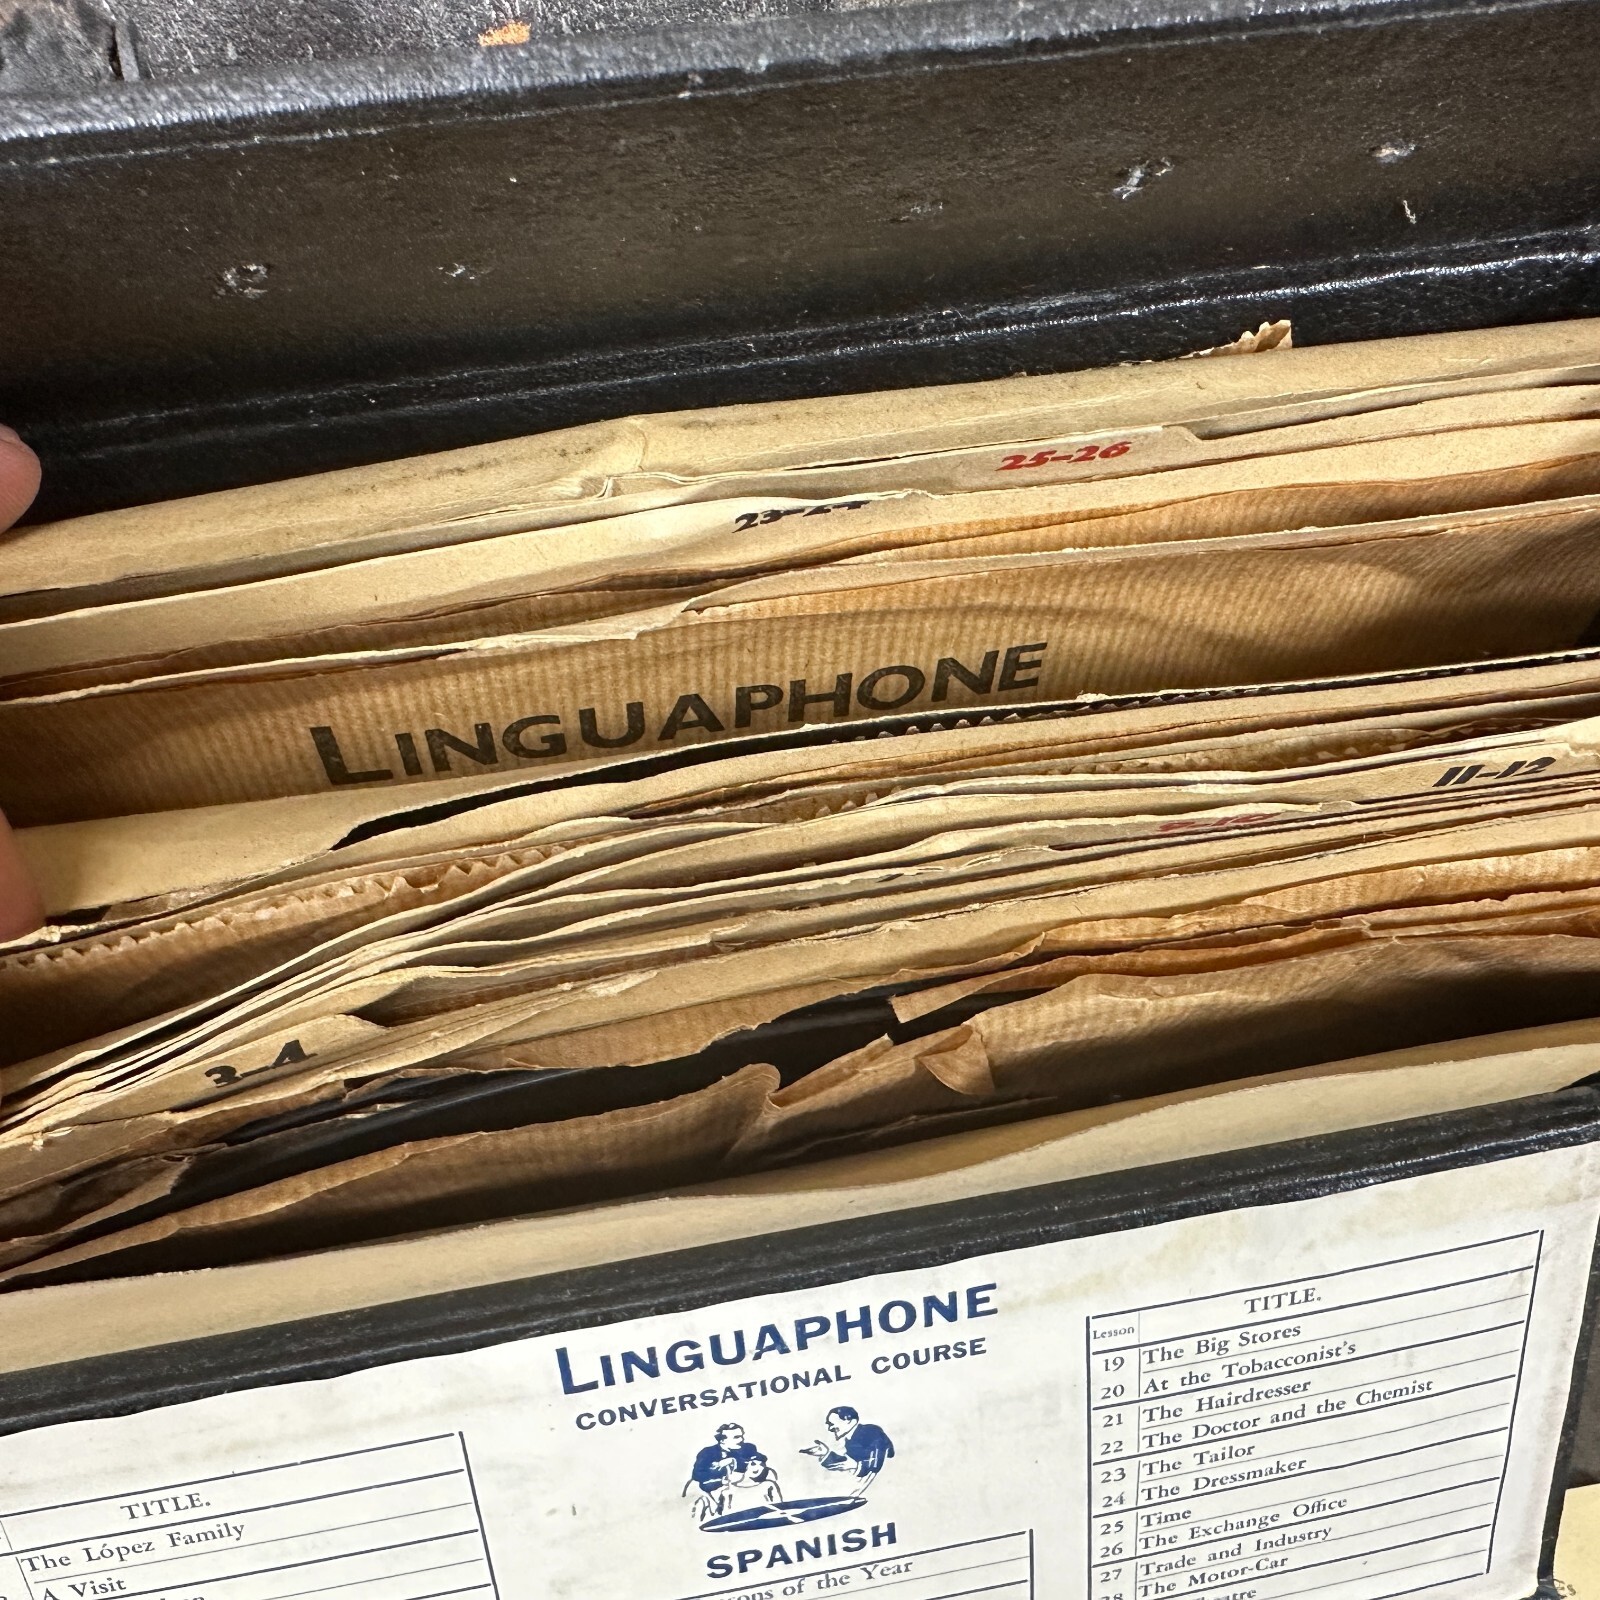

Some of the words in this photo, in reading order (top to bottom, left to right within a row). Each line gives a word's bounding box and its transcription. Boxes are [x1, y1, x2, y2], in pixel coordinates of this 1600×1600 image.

[995, 441, 1132, 471] 25-26
[1432, 756, 1557, 788] 11-12
[1244, 1288, 1322, 1314] TITLE.
[1092, 1326, 1135, 1340] Lesson
[1104, 1357, 1125, 1372] 19
[1143, 1346, 1184, 1364] The
[1195, 1337, 1230, 1356] Big
[1238, 1325, 1301, 1346] Stores
[575, 1364, 852, 1431] CONVERSATIONAL
[870, 1337, 988, 1374] COURSE
[1101, 1384, 1125, 1400] 20
[1144, 1378, 1169, 1394] At
[1181, 1371, 1211, 1386] the
[1222, 1340, 1356, 1378] Tobacconist's
[1100, 1441, 1124, 1455] 22
[1143, 1431, 1183, 1448] The
[1192, 1417, 1261, 1439] Doctor
[1270, 1404, 1306, 1424] and
[1316, 1399, 1346, 1415] the
[1356, 1379, 1433, 1406] Chemist
[1102, 1413, 1124, 1428] 21
[1143, 1404, 1183, 1423] The
[1195, 1379, 1312, 1413] Hairdresser
[1100, 1467, 1126, 1484] 23
[1142, 1459, 1183, 1476] The
[1194, 1446, 1255, 1467] Tailor
[1102, 1491, 1125, 1508] 24
[1141, 1485, 1180, 1501] The
[1193, 1460, 1307, 1491] Dressmaker
[120, 1492, 212, 1521] TITLE.
[1100, 1521, 1124, 1536] 25
[1141, 1509, 1192, 1528] Time
[1100, 1542, 1123, 1558] 26
[1139, 1532, 1178, 1550] The
[1188, 1513, 1280, 1540] Exchange
[1293, 1498, 1348, 1517] Office
[20, 1554, 71, 1572] The
[82, 1541, 155, 1562] López
[166, 1521, 245, 1547] Family
[706, 1522, 898, 1578] SPANISH
[1100, 1568, 1122, 1583] 27
[1140, 1555, 1196, 1576] Trade
[1208, 1543, 1242, 1562] and
[1255, 1527, 1332, 1551] Industry
[43, 1588, 60, 1600] A
[68, 1578, 127, 1597] Visit
[783, 1577, 805, 1596] of
[817, 1572, 850, 1590] the
[860, 1561, 914, 1580] Year
[1138, 1580, 1177, 1597] The
[1188, 1556, 1289, 1587] Motor-Car
